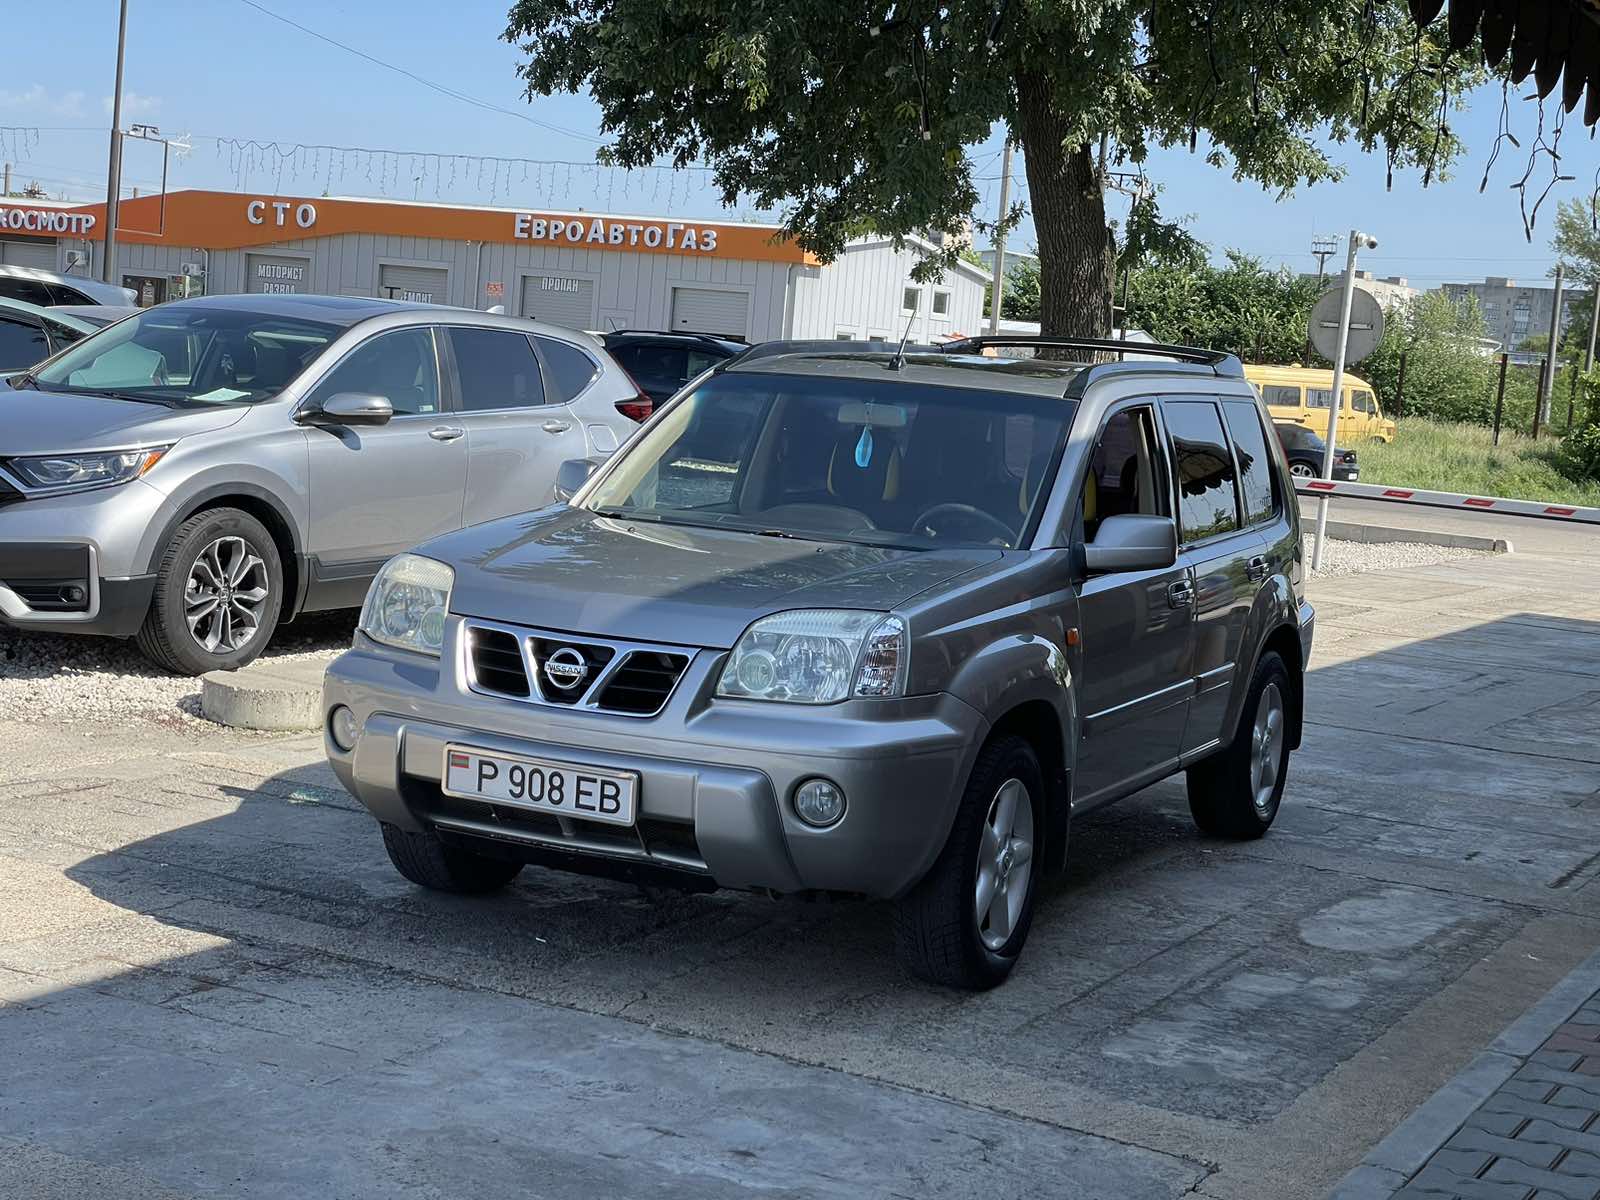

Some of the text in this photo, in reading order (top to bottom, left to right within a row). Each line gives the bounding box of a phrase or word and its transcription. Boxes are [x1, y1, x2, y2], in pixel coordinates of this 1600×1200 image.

[247, 200, 317, 228] СТО
[258, 264, 303, 281] МОТОРИСТ
[541, 277, 579, 292] ПРОПАН
[400, 290, 433, 304] ЕМОНТ
[547, 663, 582, 674] NISSAN
[477, 759, 621, 815] P 908 EB
